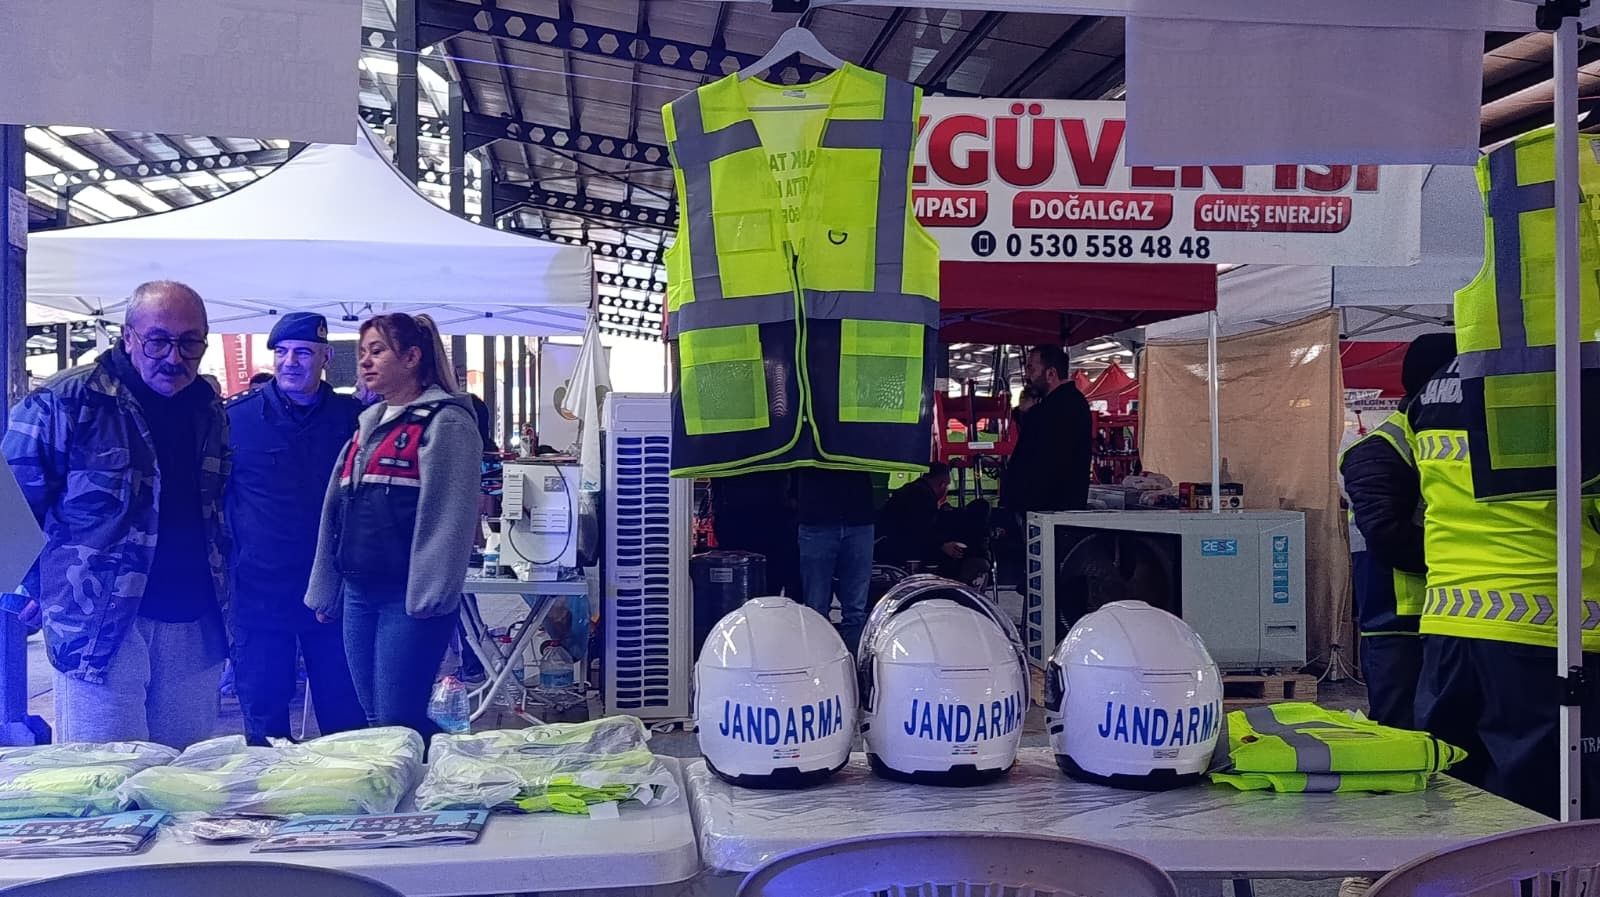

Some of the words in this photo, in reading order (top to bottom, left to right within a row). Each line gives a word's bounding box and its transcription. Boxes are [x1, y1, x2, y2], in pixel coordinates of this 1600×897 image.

[1030, 195, 1154, 220] DOĞALGAZ
[1201, 200, 1260, 228] GÜNEŞ
[1265, 202, 1343, 225] ENERJİSİ
[1006, 234, 1021, 257] 0
[1030, 234, 1077, 257] 530
[1085, 235, 1133, 258] 558
[1140, 236, 1172, 259] 48
[1179, 236, 1210, 259] 48
[719, 695, 842, 745] JANDARMA
[904, 690, 1021, 743] JANDARMA
[1098, 699, 1219, 746] JANDARMA
